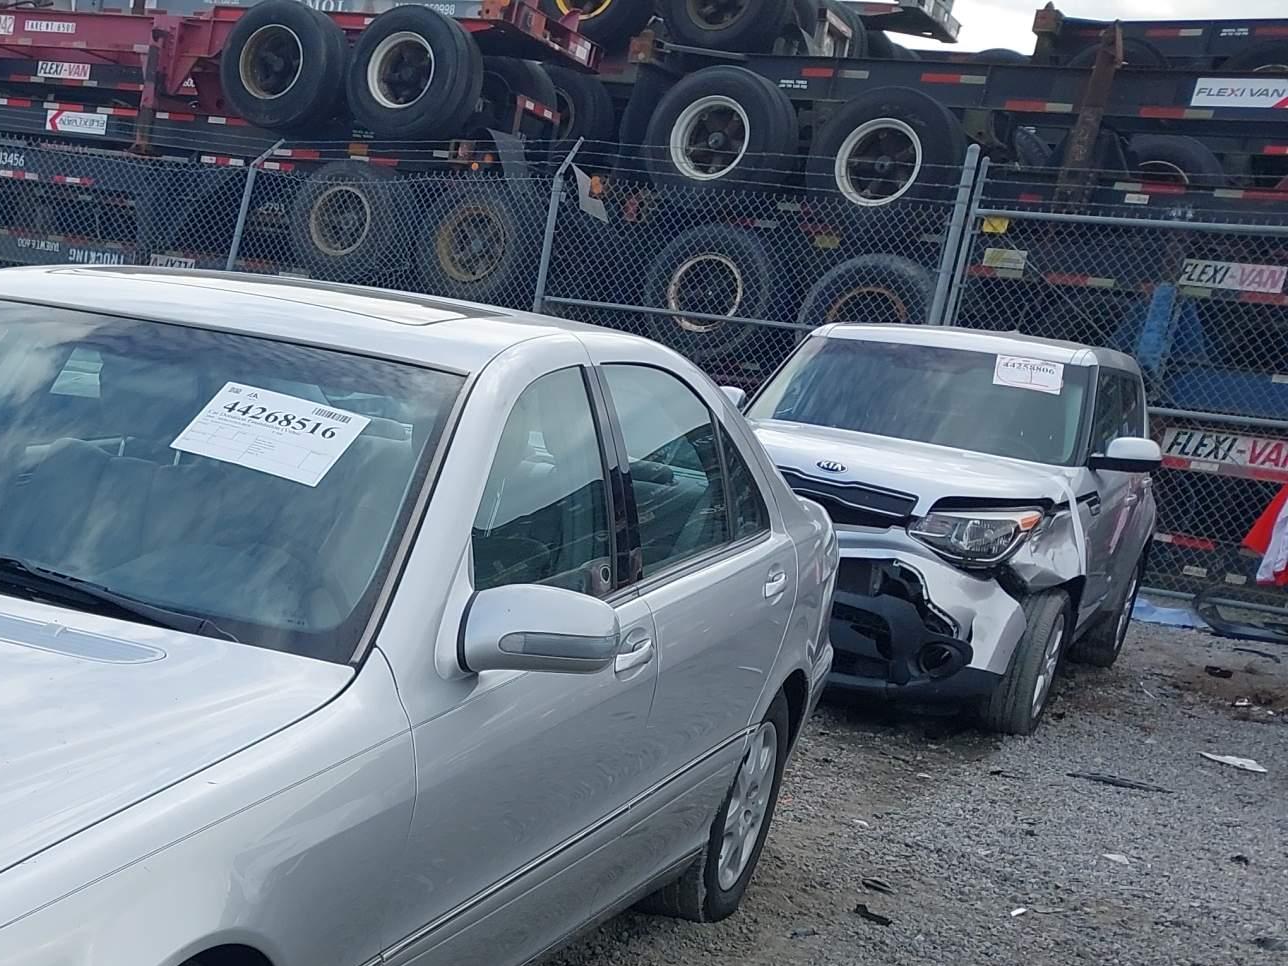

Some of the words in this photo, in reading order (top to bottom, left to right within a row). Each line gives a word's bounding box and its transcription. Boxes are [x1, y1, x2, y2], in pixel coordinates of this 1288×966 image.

[39, 63, 89, 77] FLEXI-VAN
[1195, 87, 1245, 97] FLEXI
[1250, 88, 1286, 97] VAN
[1184, 262, 1284, 289] FLEXI-VAN
[223, 400, 342, 440] 44268516
[820, 461, 842, 471] KIA
